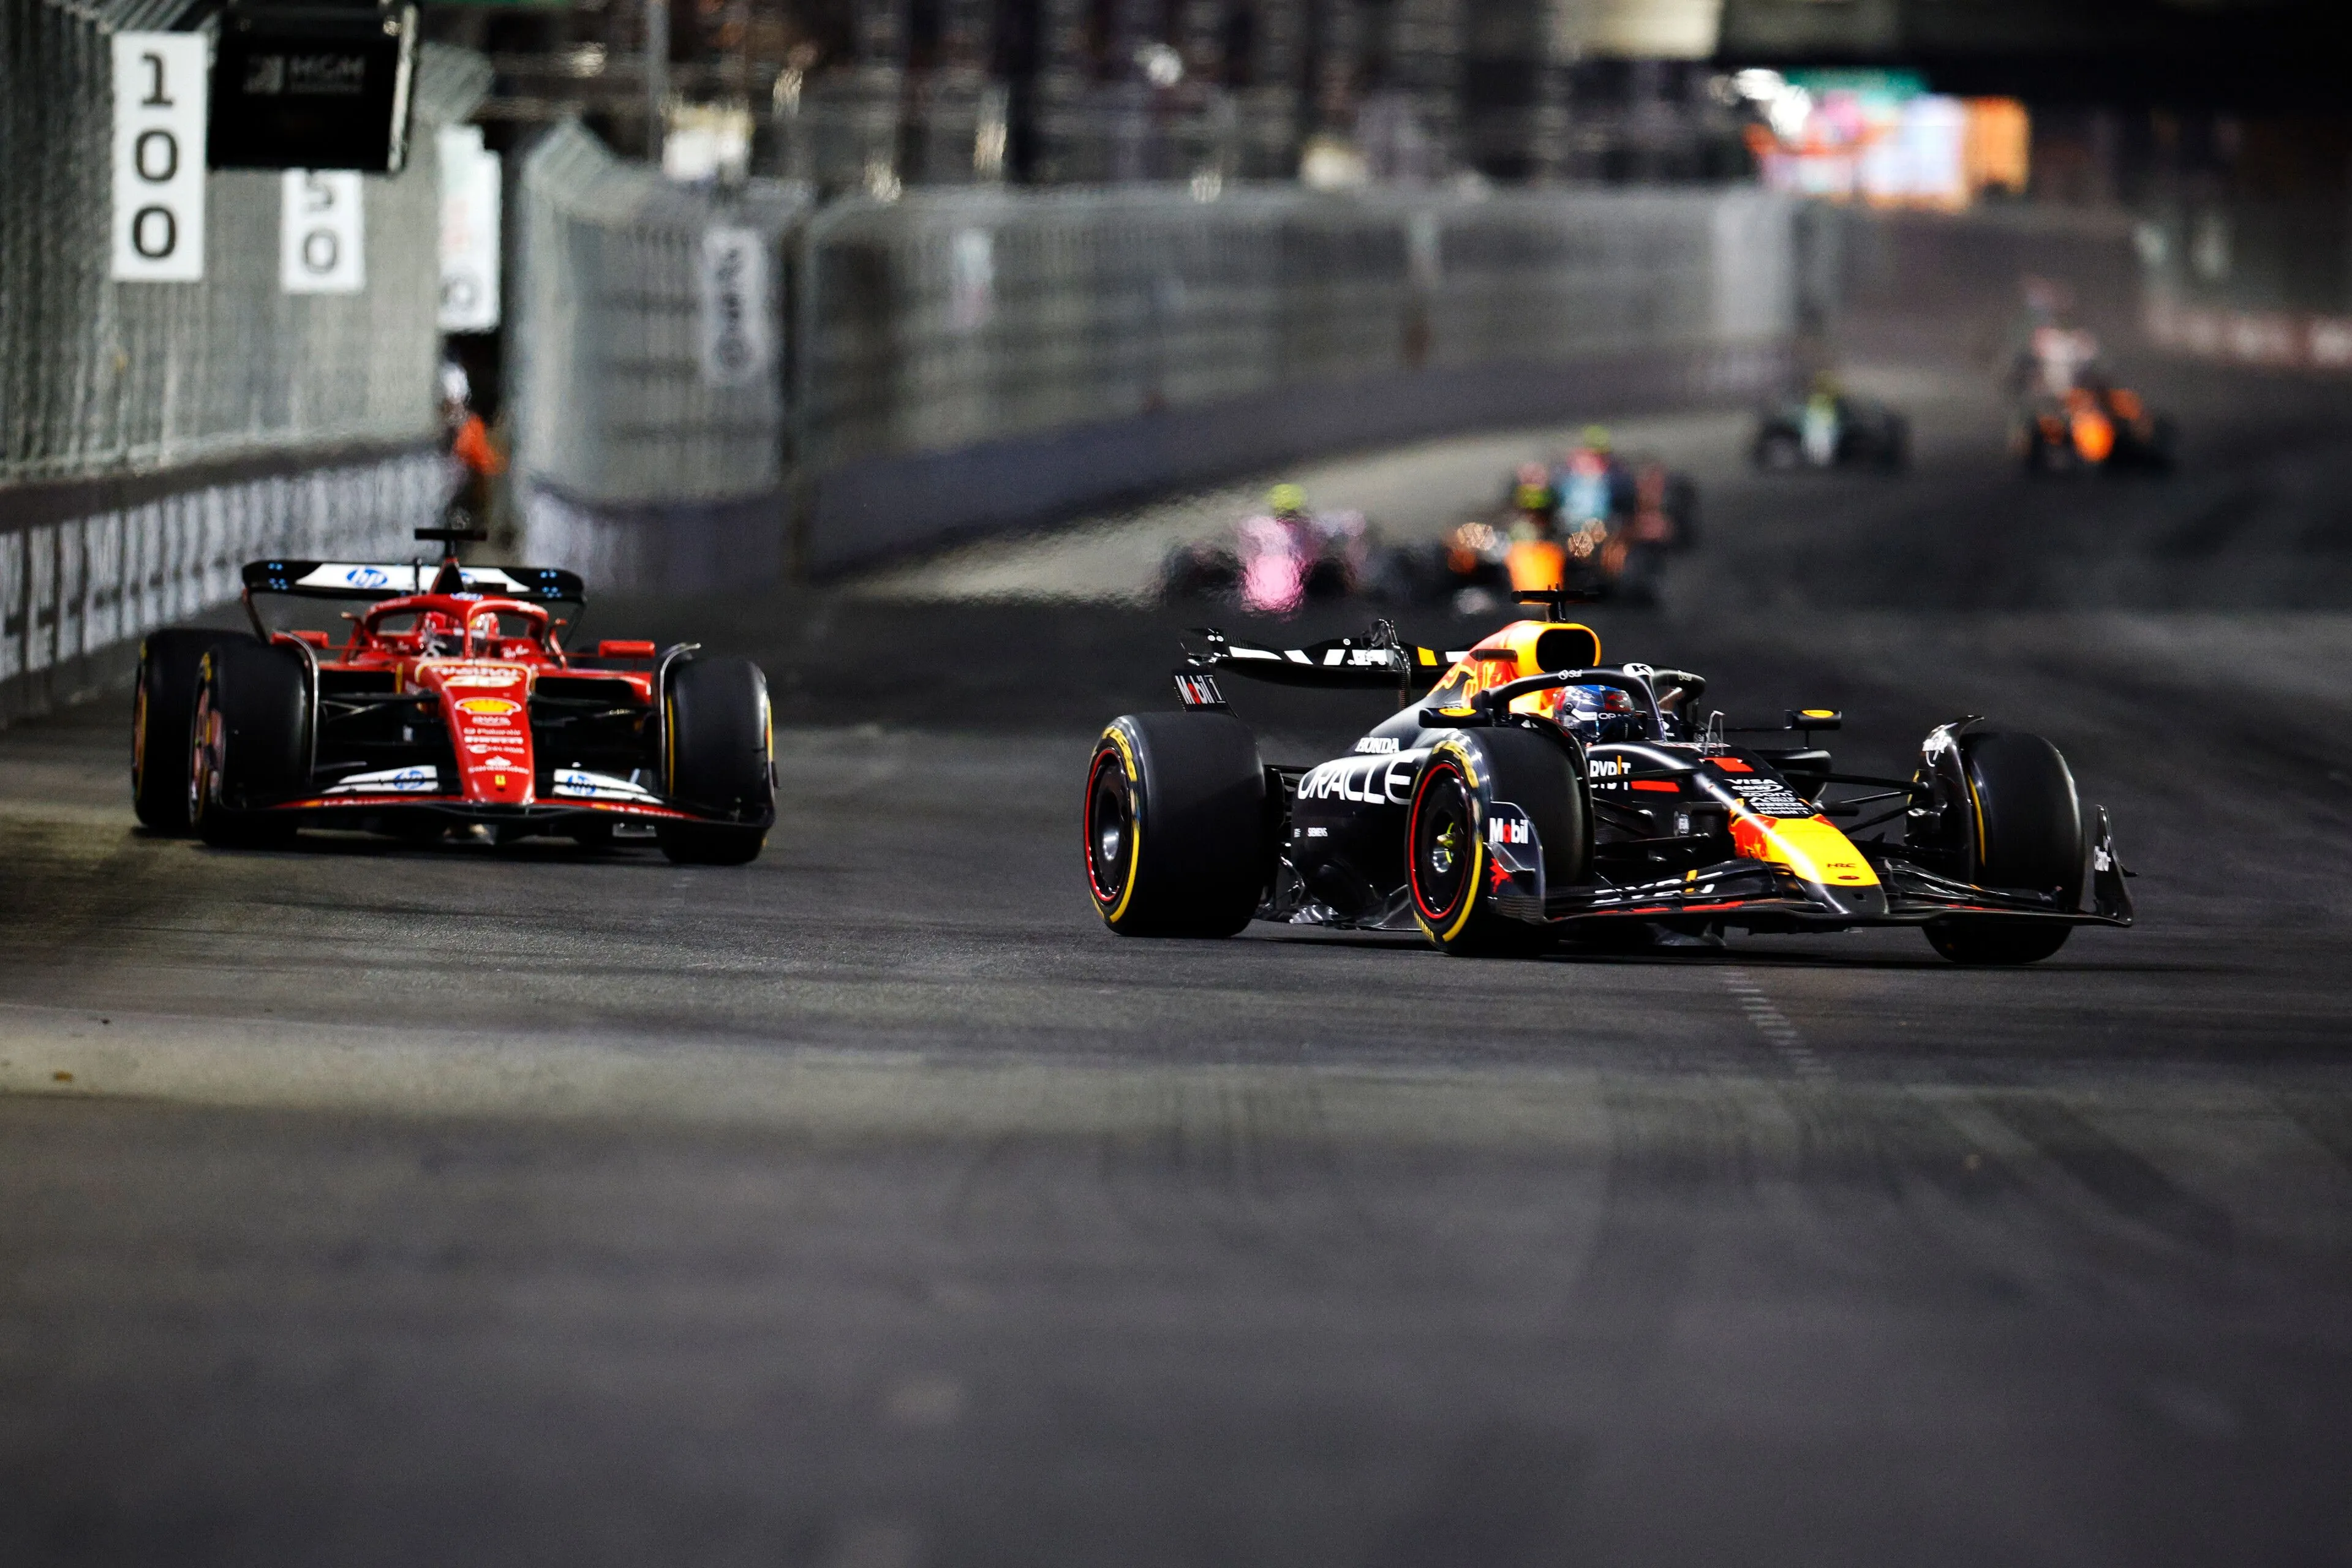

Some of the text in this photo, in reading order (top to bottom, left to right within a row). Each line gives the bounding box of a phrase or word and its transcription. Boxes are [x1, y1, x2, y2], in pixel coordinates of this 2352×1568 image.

[132, 53, 178, 258] 100
[1175, 675, 1215, 704] Mobil
[1355, 737, 1400, 753] HONDA
[1298, 753, 1412, 805] ORACLE
[1489, 818, 1529, 844] Mobil
